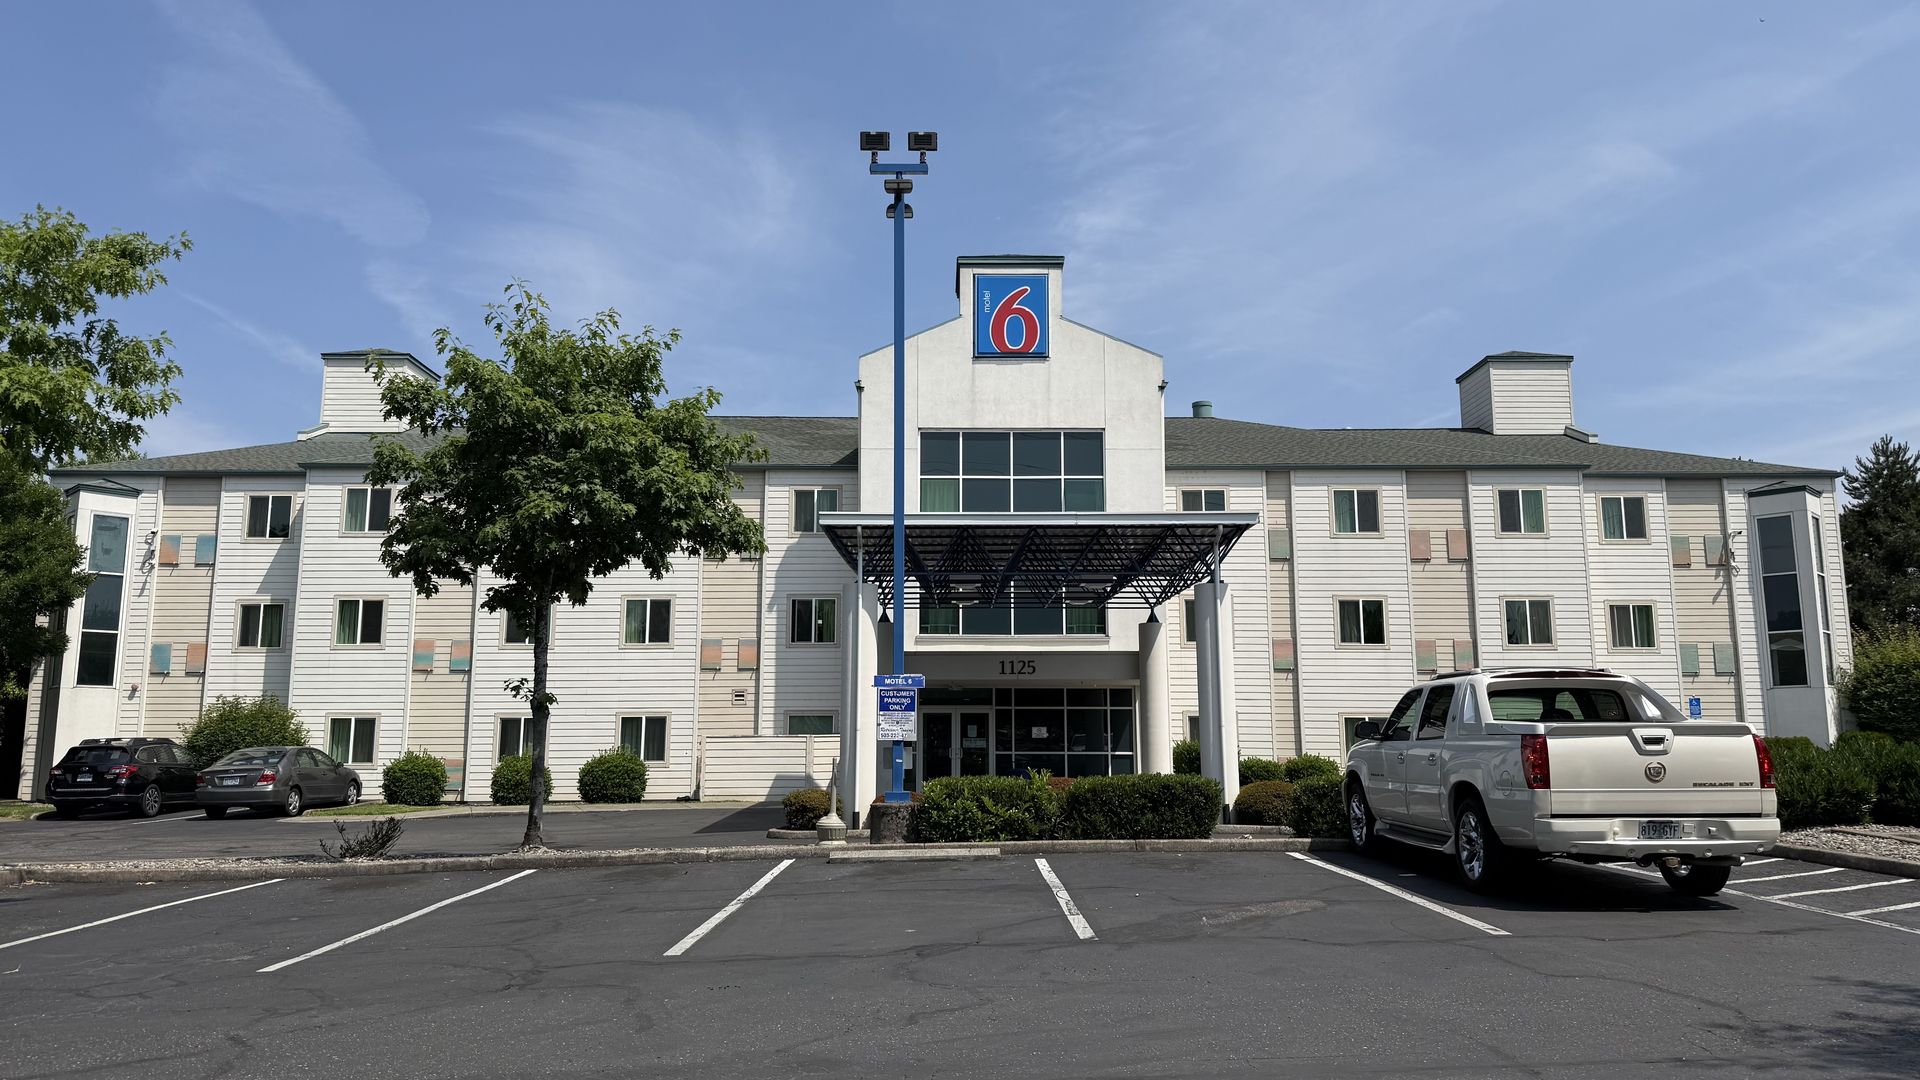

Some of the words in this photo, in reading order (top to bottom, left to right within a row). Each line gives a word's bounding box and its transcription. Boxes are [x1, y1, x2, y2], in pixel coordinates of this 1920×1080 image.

[983, 290, 991, 313] motel
[989, 286, 1040, 353] 6
[999, 660, 1036, 675] 1125
[1641, 824, 1658, 836] 819
[1662, 824, 1679, 837] GYF
